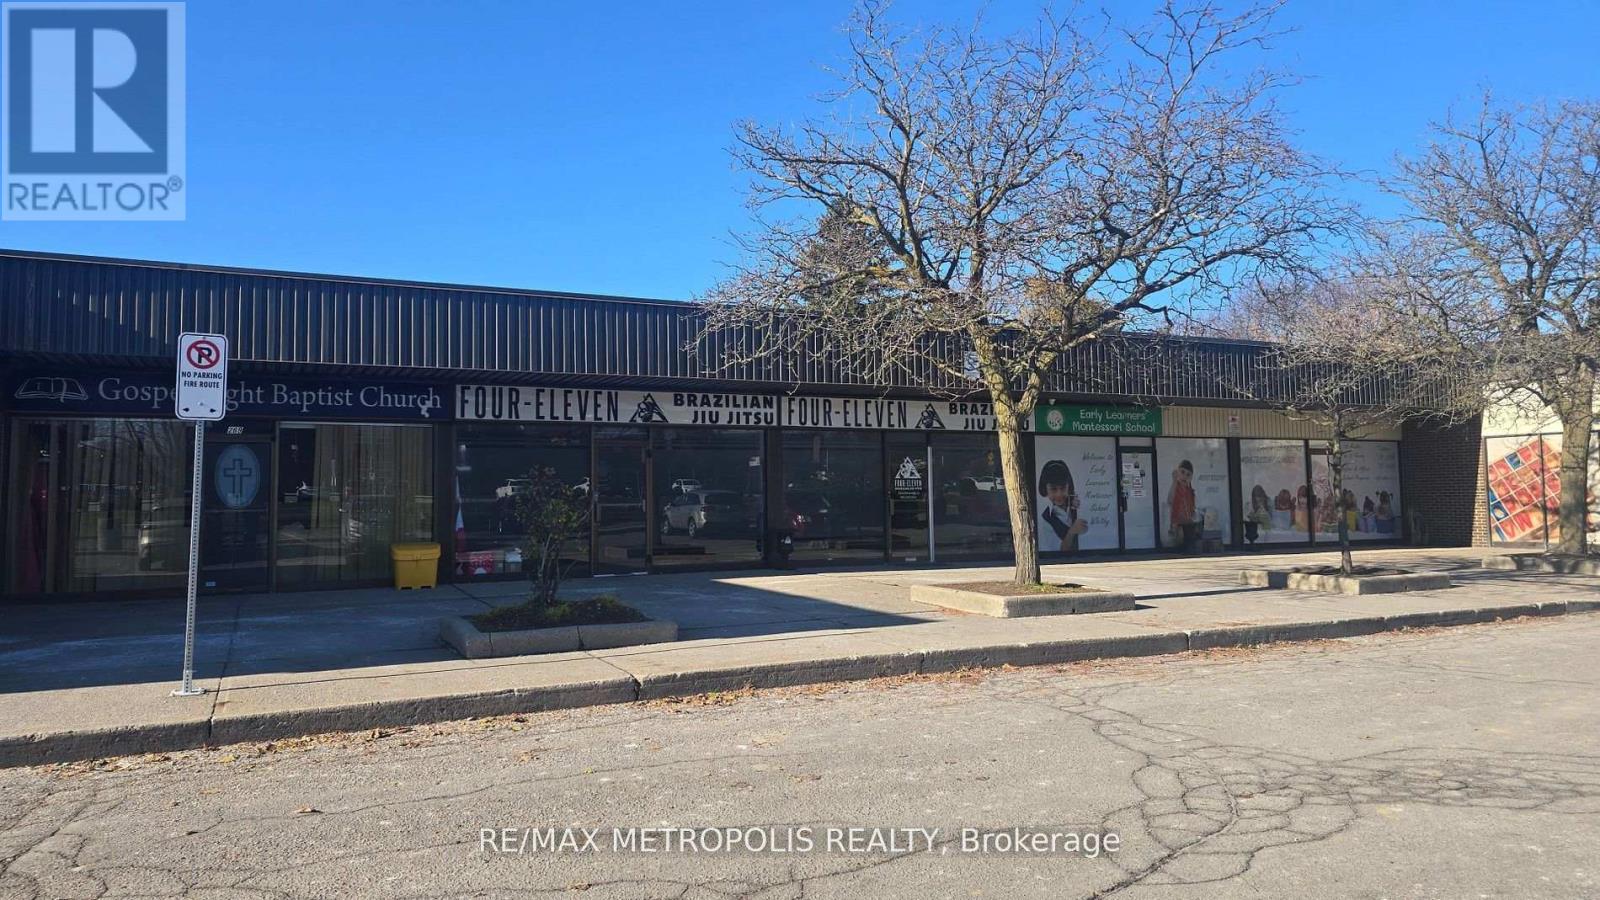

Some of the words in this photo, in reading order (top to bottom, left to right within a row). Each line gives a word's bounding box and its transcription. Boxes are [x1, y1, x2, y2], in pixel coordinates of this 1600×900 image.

[193, 371, 223, 380] PARKING
[184, 380, 198, 388] FIRE
[199, 381, 220, 389] ROUTE
[271, 383, 353, 412] Baptist
[359, 386, 442, 409] Church
[460, 385, 619, 422] FOUR-ELEVEN
[673, 393, 774, 409] BRAZILIAN
[787, 397, 907, 428] FOUR-ELEVEN
[949, 403, 994, 416] BRAZI
[1080, 408, 1102, 422] Early
[691, 410, 720, 424] JIU
[726, 411, 774, 425] JITSU
[964, 417, 986, 430] JIU
[1072, 421, 1122, 431] Montessori
[1125, 422, 1156, 432] School
